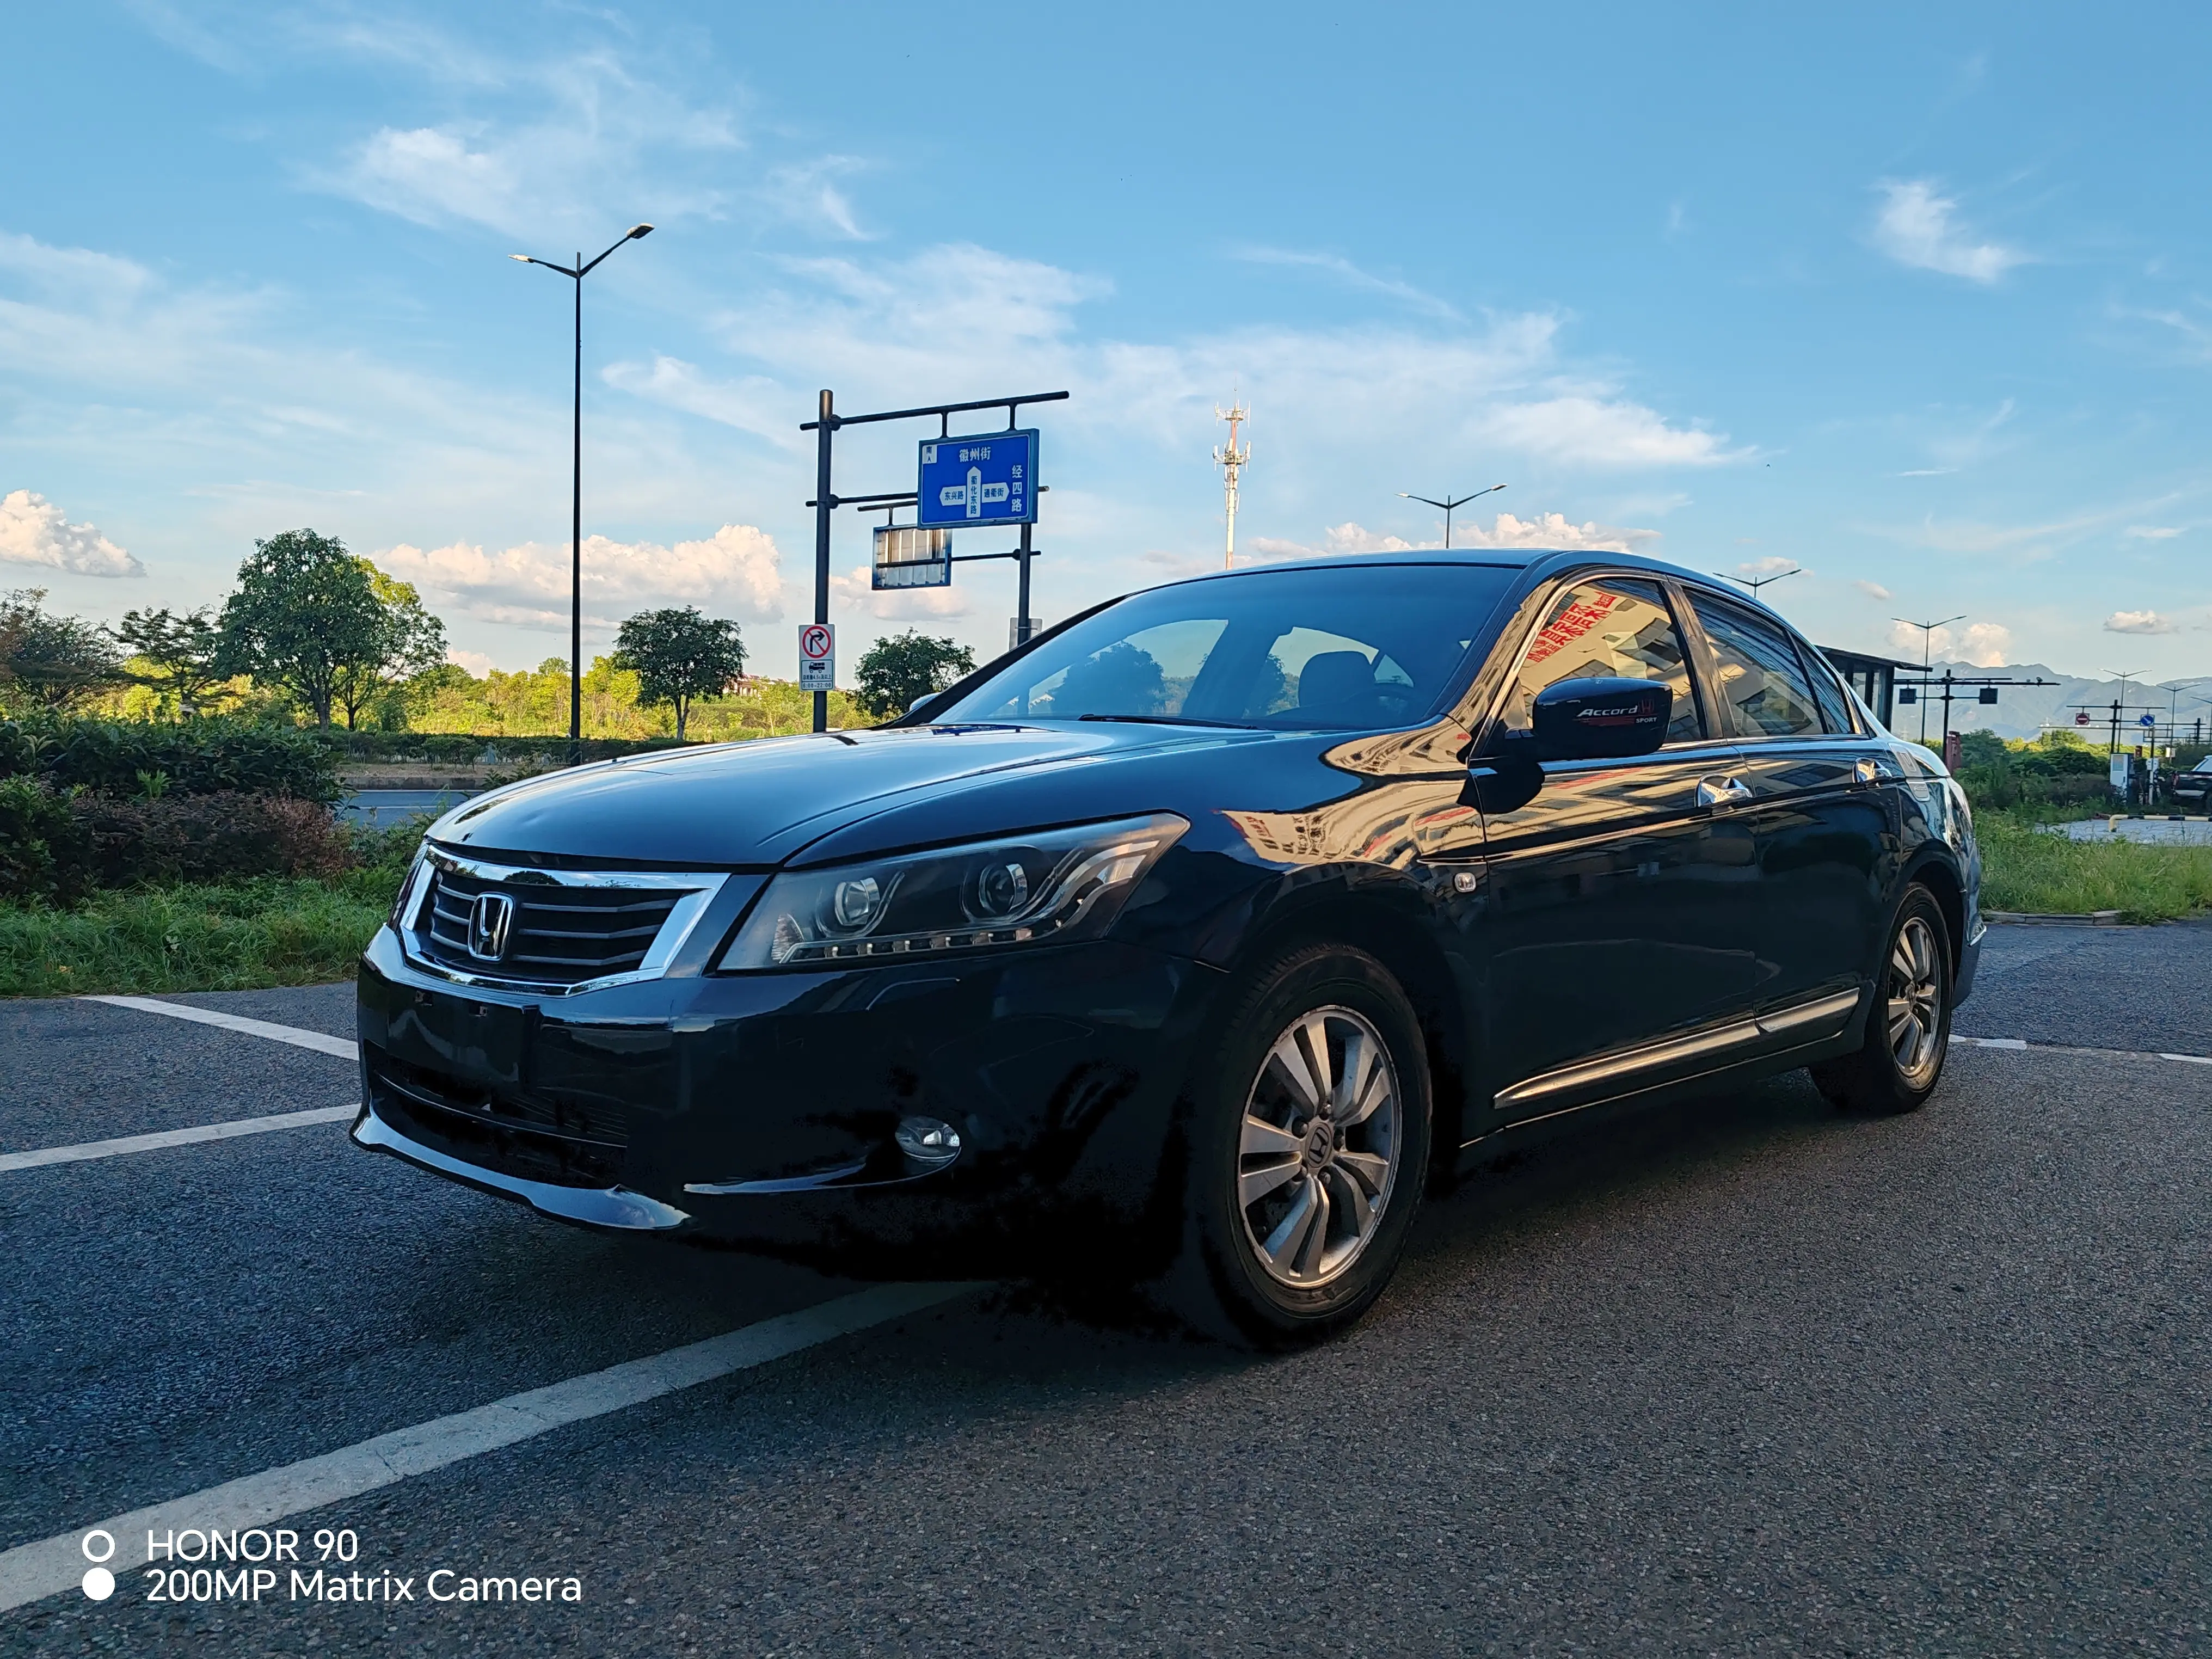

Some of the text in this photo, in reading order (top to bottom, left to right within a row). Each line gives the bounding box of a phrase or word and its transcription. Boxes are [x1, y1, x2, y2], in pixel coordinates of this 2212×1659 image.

[959, 446, 991, 463] 徽州街
[944, 490, 964, 501] 东兴路
[970, 475, 978, 515] 衢化东路
[984, 487, 1004, 498] 通衢街
[1011, 465, 1023, 512] 经四路
[1576, 705, 1638, 717] Accord
